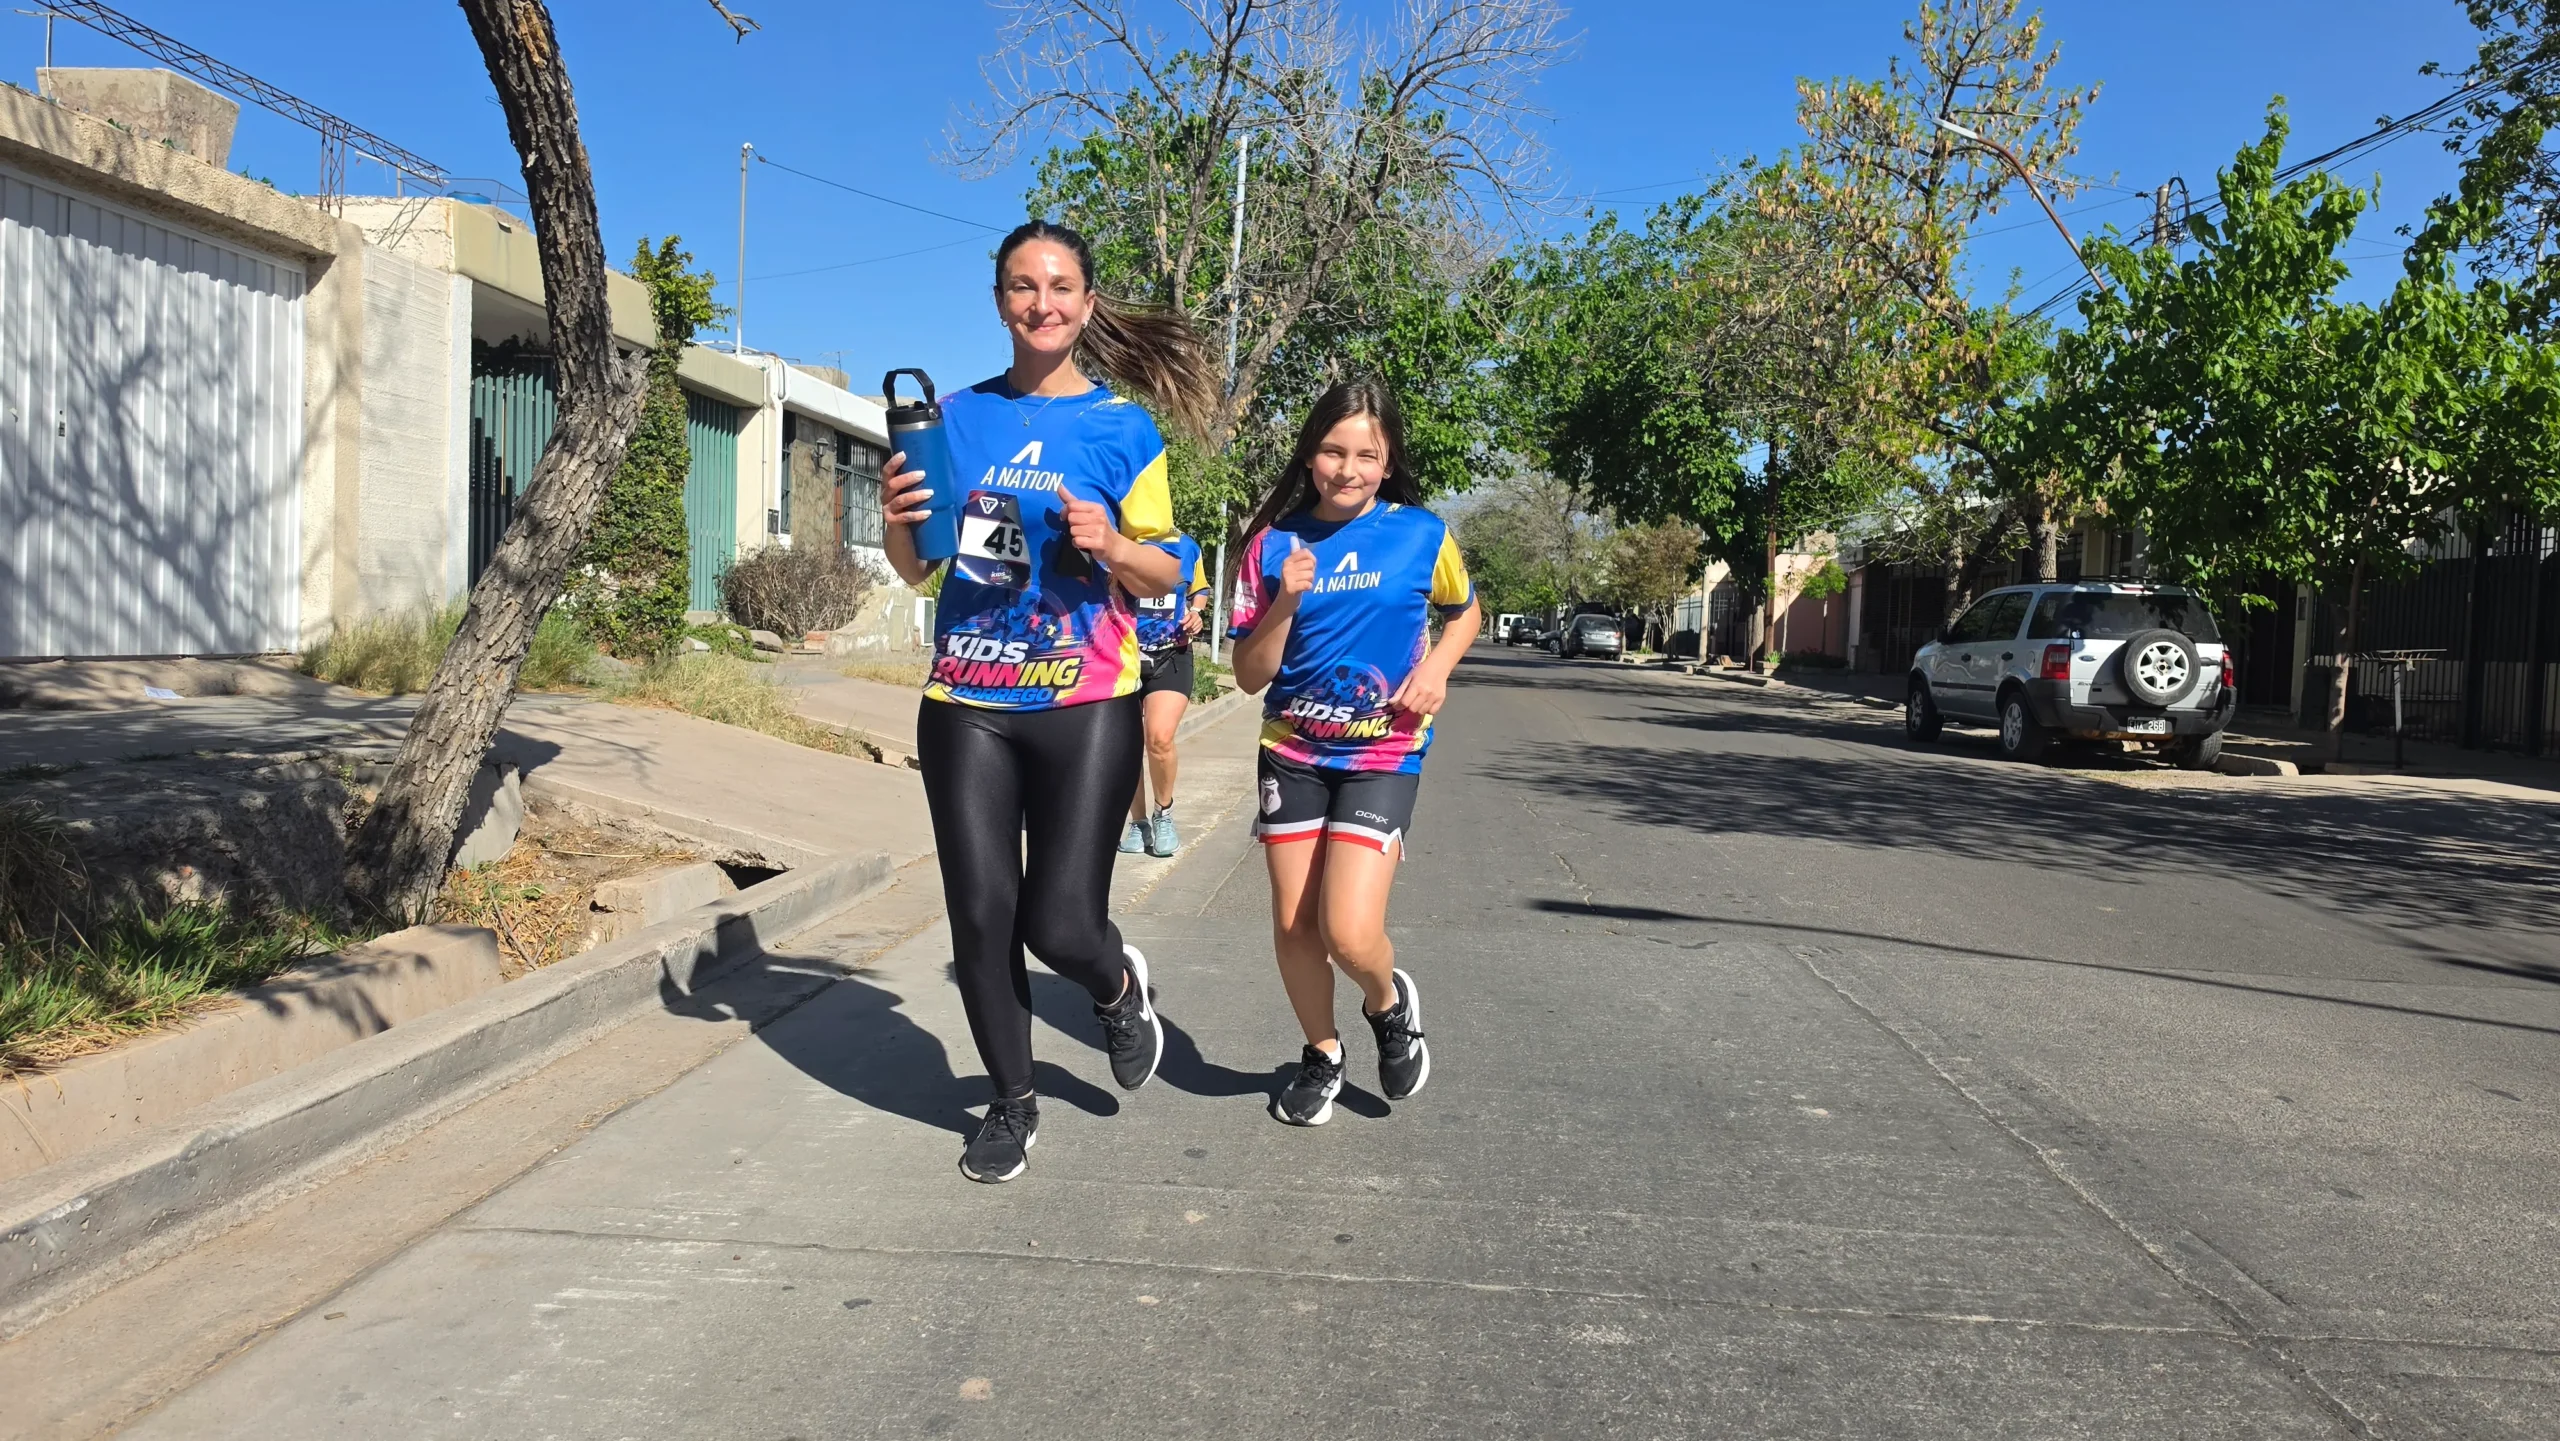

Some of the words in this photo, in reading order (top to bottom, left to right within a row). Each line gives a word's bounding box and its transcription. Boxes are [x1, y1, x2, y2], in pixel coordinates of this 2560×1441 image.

[980, 465, 996, 486] A
[996, 467, 1065, 492] NATION
[983, 525, 1023, 557] 45
[1313, 577, 1324, 594] A
[1326, 571, 1382, 593] NATION
[1152, 596, 1165, 607] 18
[947, 634, 1030, 664] KIDS
[934, 656, 1081, 688] RUNNING
[952, 684, 1054, 704] DORREGO
[1288, 696, 1356, 723] KIDS
[2148, 720, 2164, 731] 268
[1354, 809, 1389, 825] OCNX
